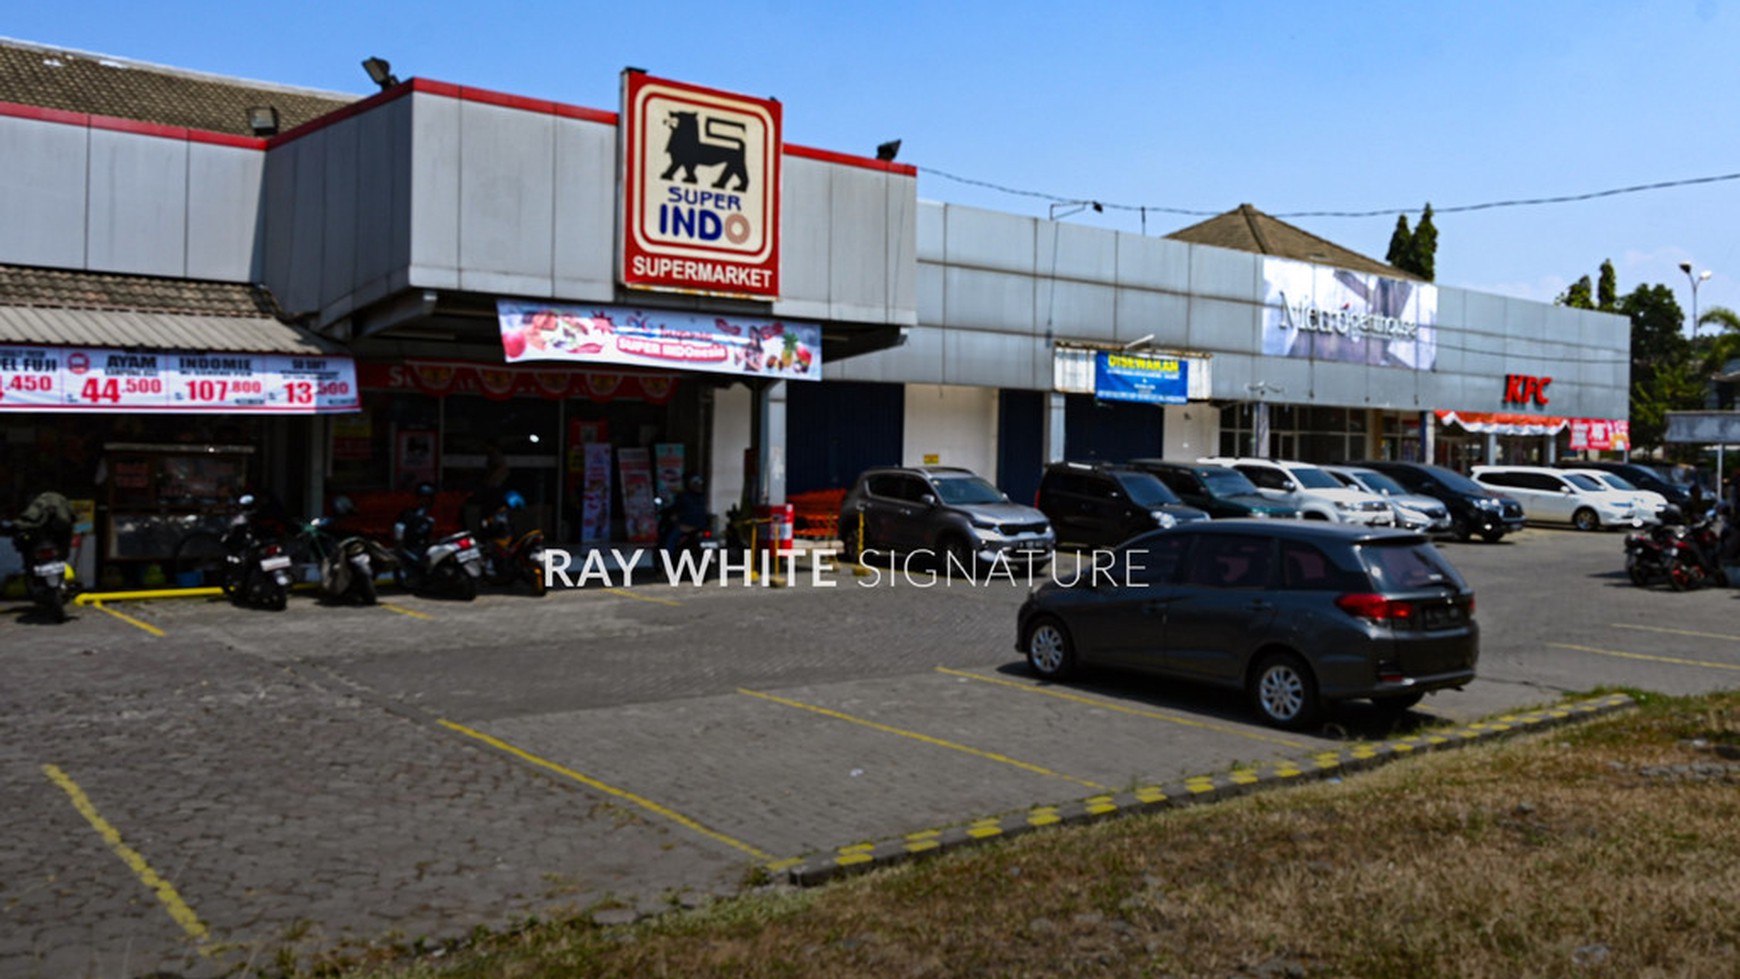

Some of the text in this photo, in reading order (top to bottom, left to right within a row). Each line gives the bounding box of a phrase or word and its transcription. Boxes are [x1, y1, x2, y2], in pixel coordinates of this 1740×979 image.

[668, 187, 742, 211] SUPER
[659, 203, 752, 245] INDO
[633, 256, 772, 288] SUPERMARKET
[23, 358, 57, 372] FUJI
[106, 355, 156, 368] AYAM
[179, 357, 252, 370] INDOMIE
[1504, 374, 1552, 405] KFC
